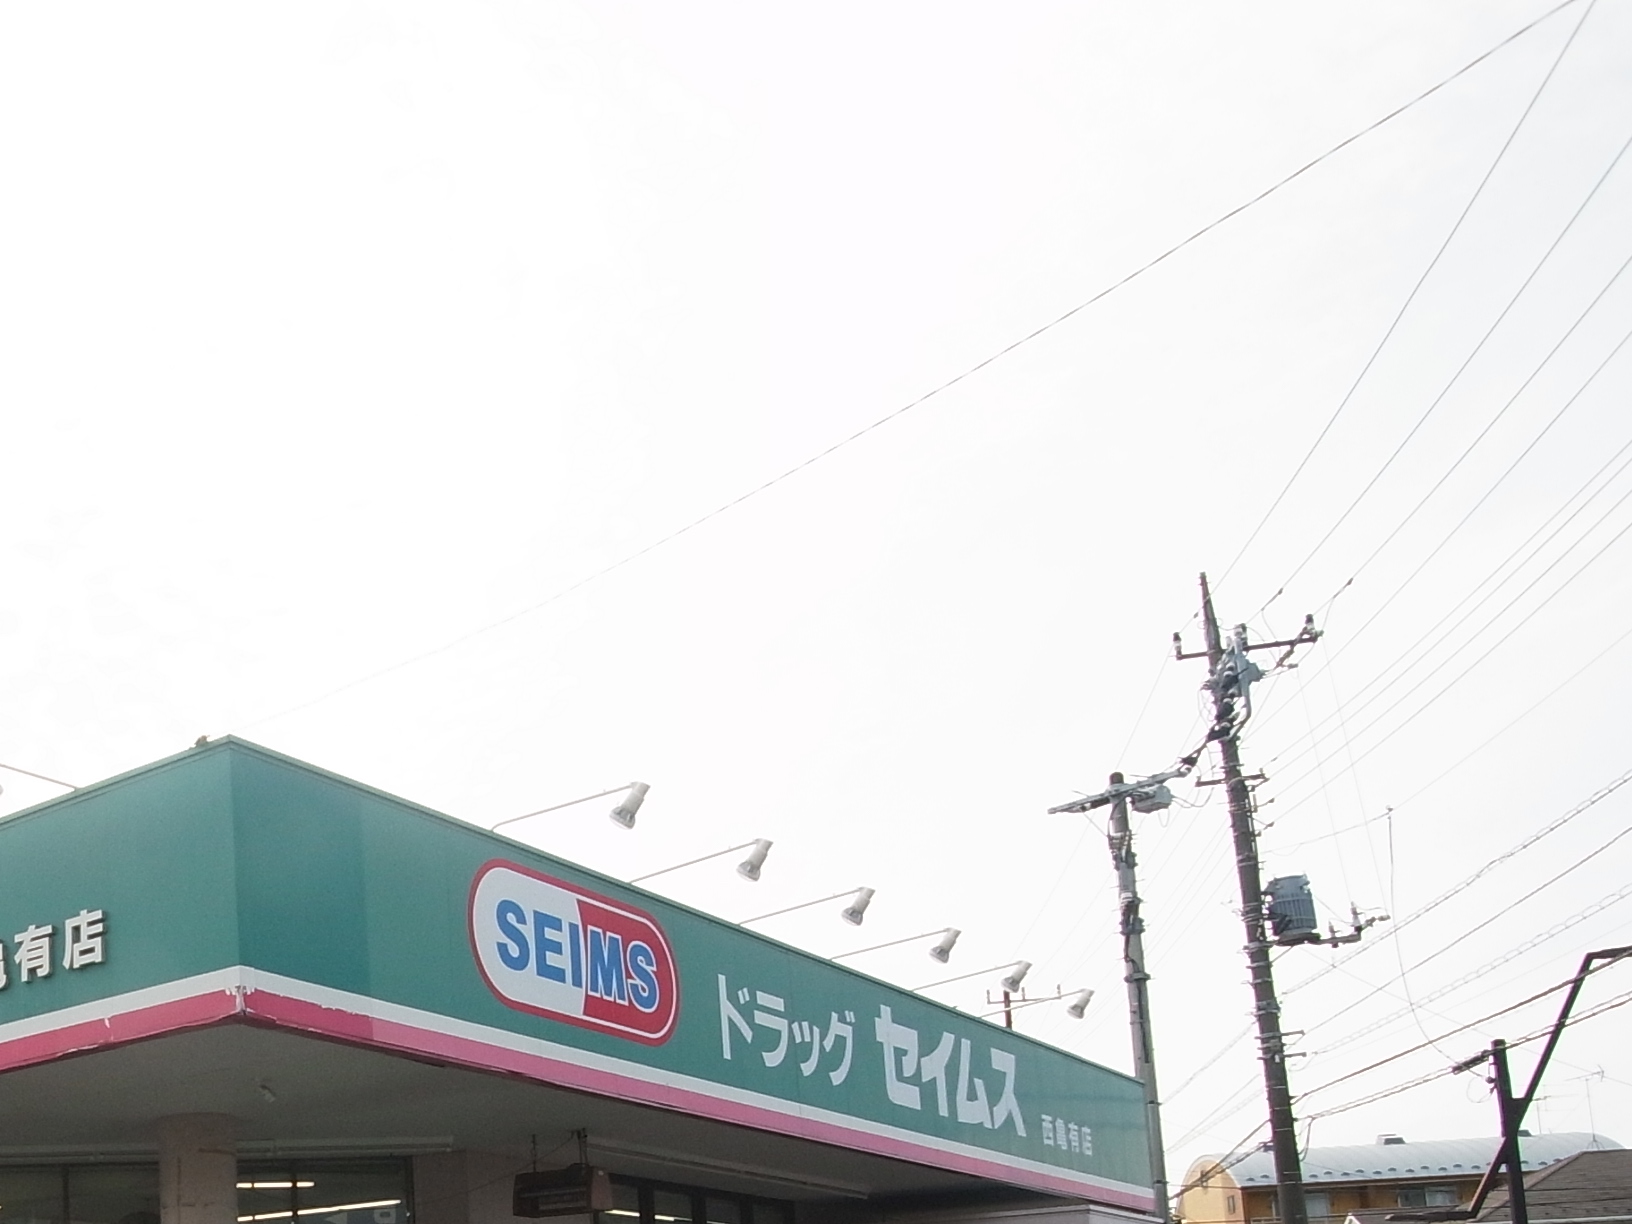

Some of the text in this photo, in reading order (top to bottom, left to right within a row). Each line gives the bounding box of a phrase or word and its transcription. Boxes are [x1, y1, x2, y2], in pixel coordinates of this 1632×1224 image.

[494, 899, 659, 1013] SEIMS
[718, 973, 1027, 1138] ドラッグ セイムス
[1040, 1113, 1093, 1157] 西亀有店
